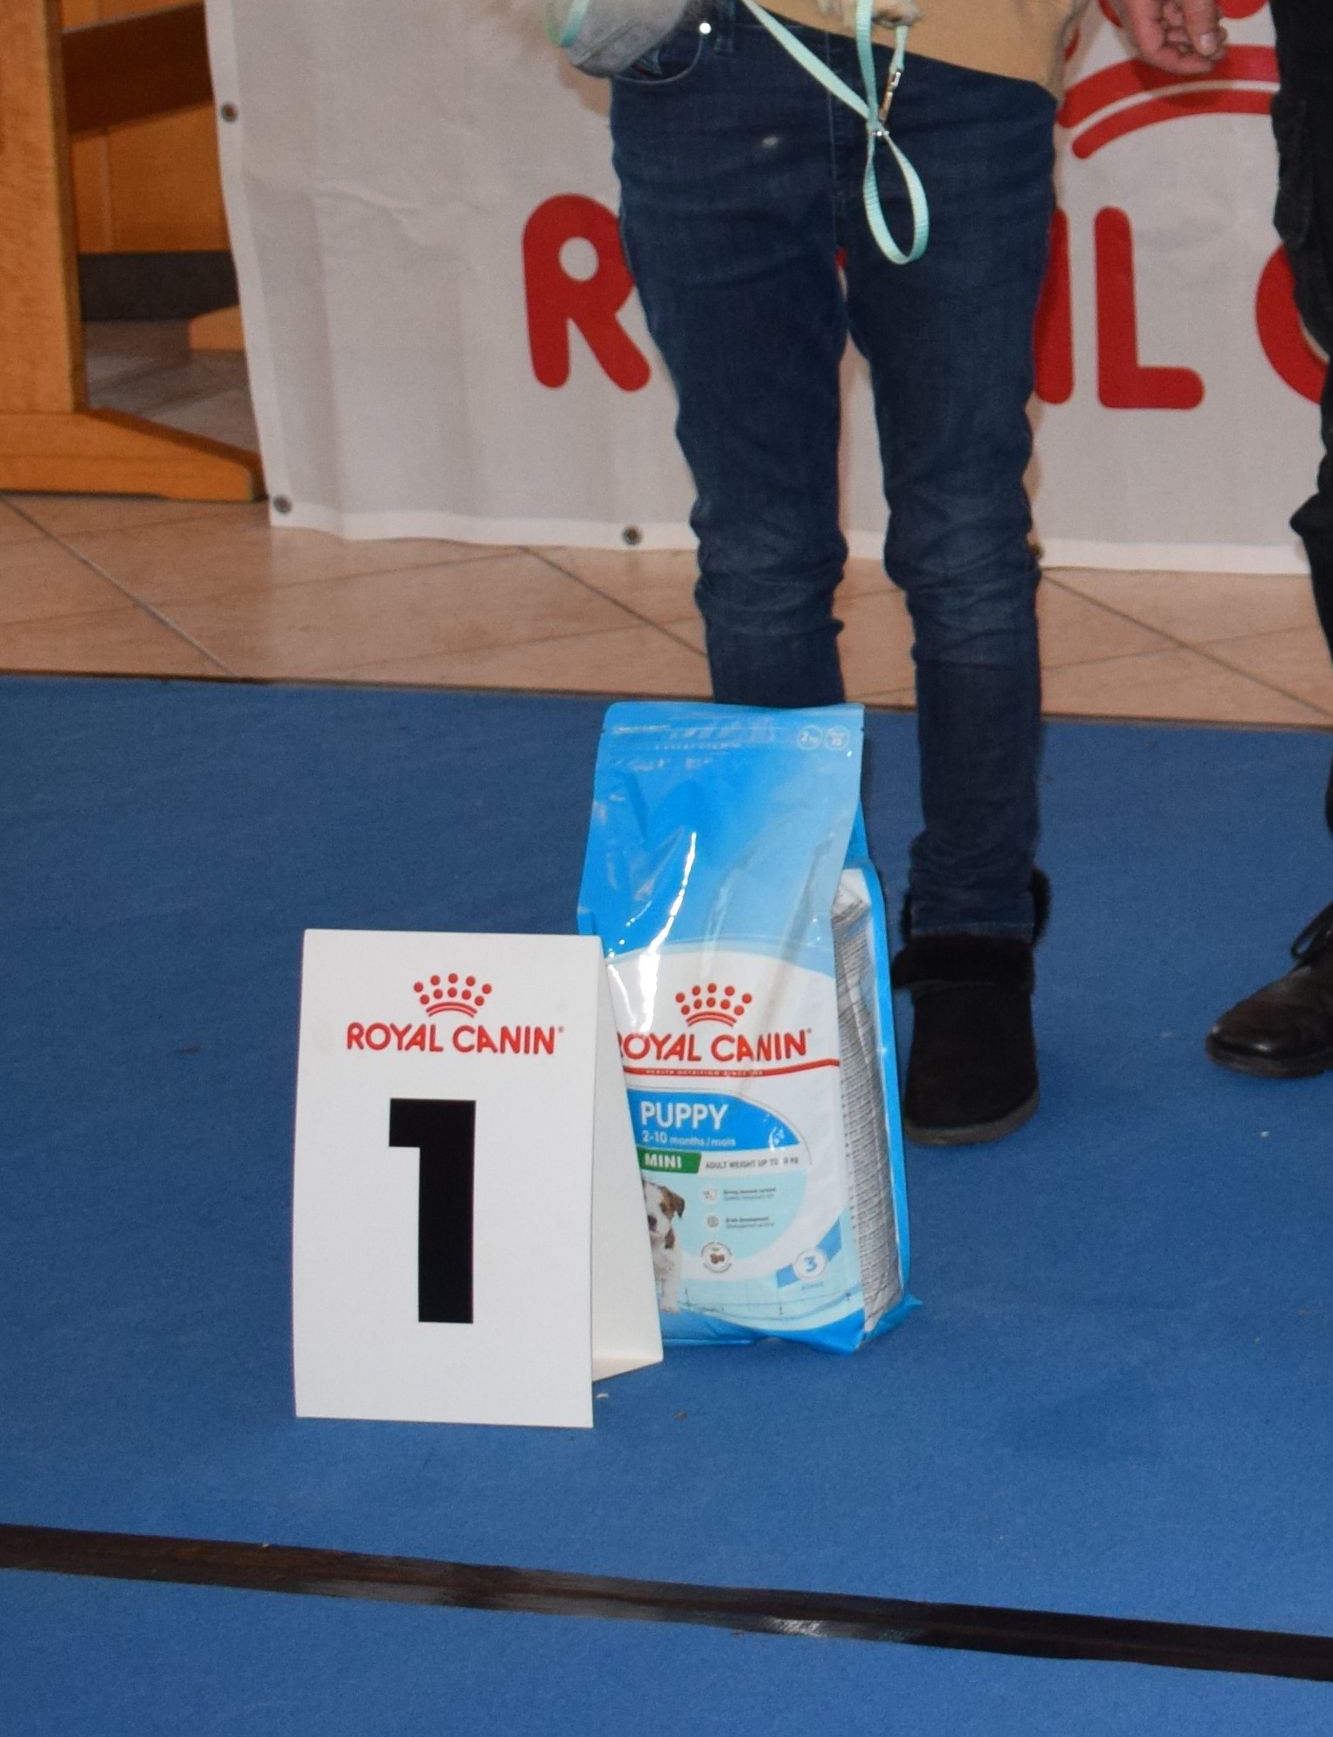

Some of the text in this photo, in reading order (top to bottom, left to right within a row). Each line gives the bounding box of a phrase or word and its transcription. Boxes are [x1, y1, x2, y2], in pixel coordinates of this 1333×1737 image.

[346, 1021, 556, 1055] ROYAL CANIN
[617, 1029, 807, 1062] OYAL CANIN
[639, 1100, 729, 1131] PUPPY
[641, 1130, 668, 1145] 2-10
[643, 1152, 683, 1170] MINI
[387, 1098, 477, 1323] 1
[803, 1255, 818, 1273] 3
